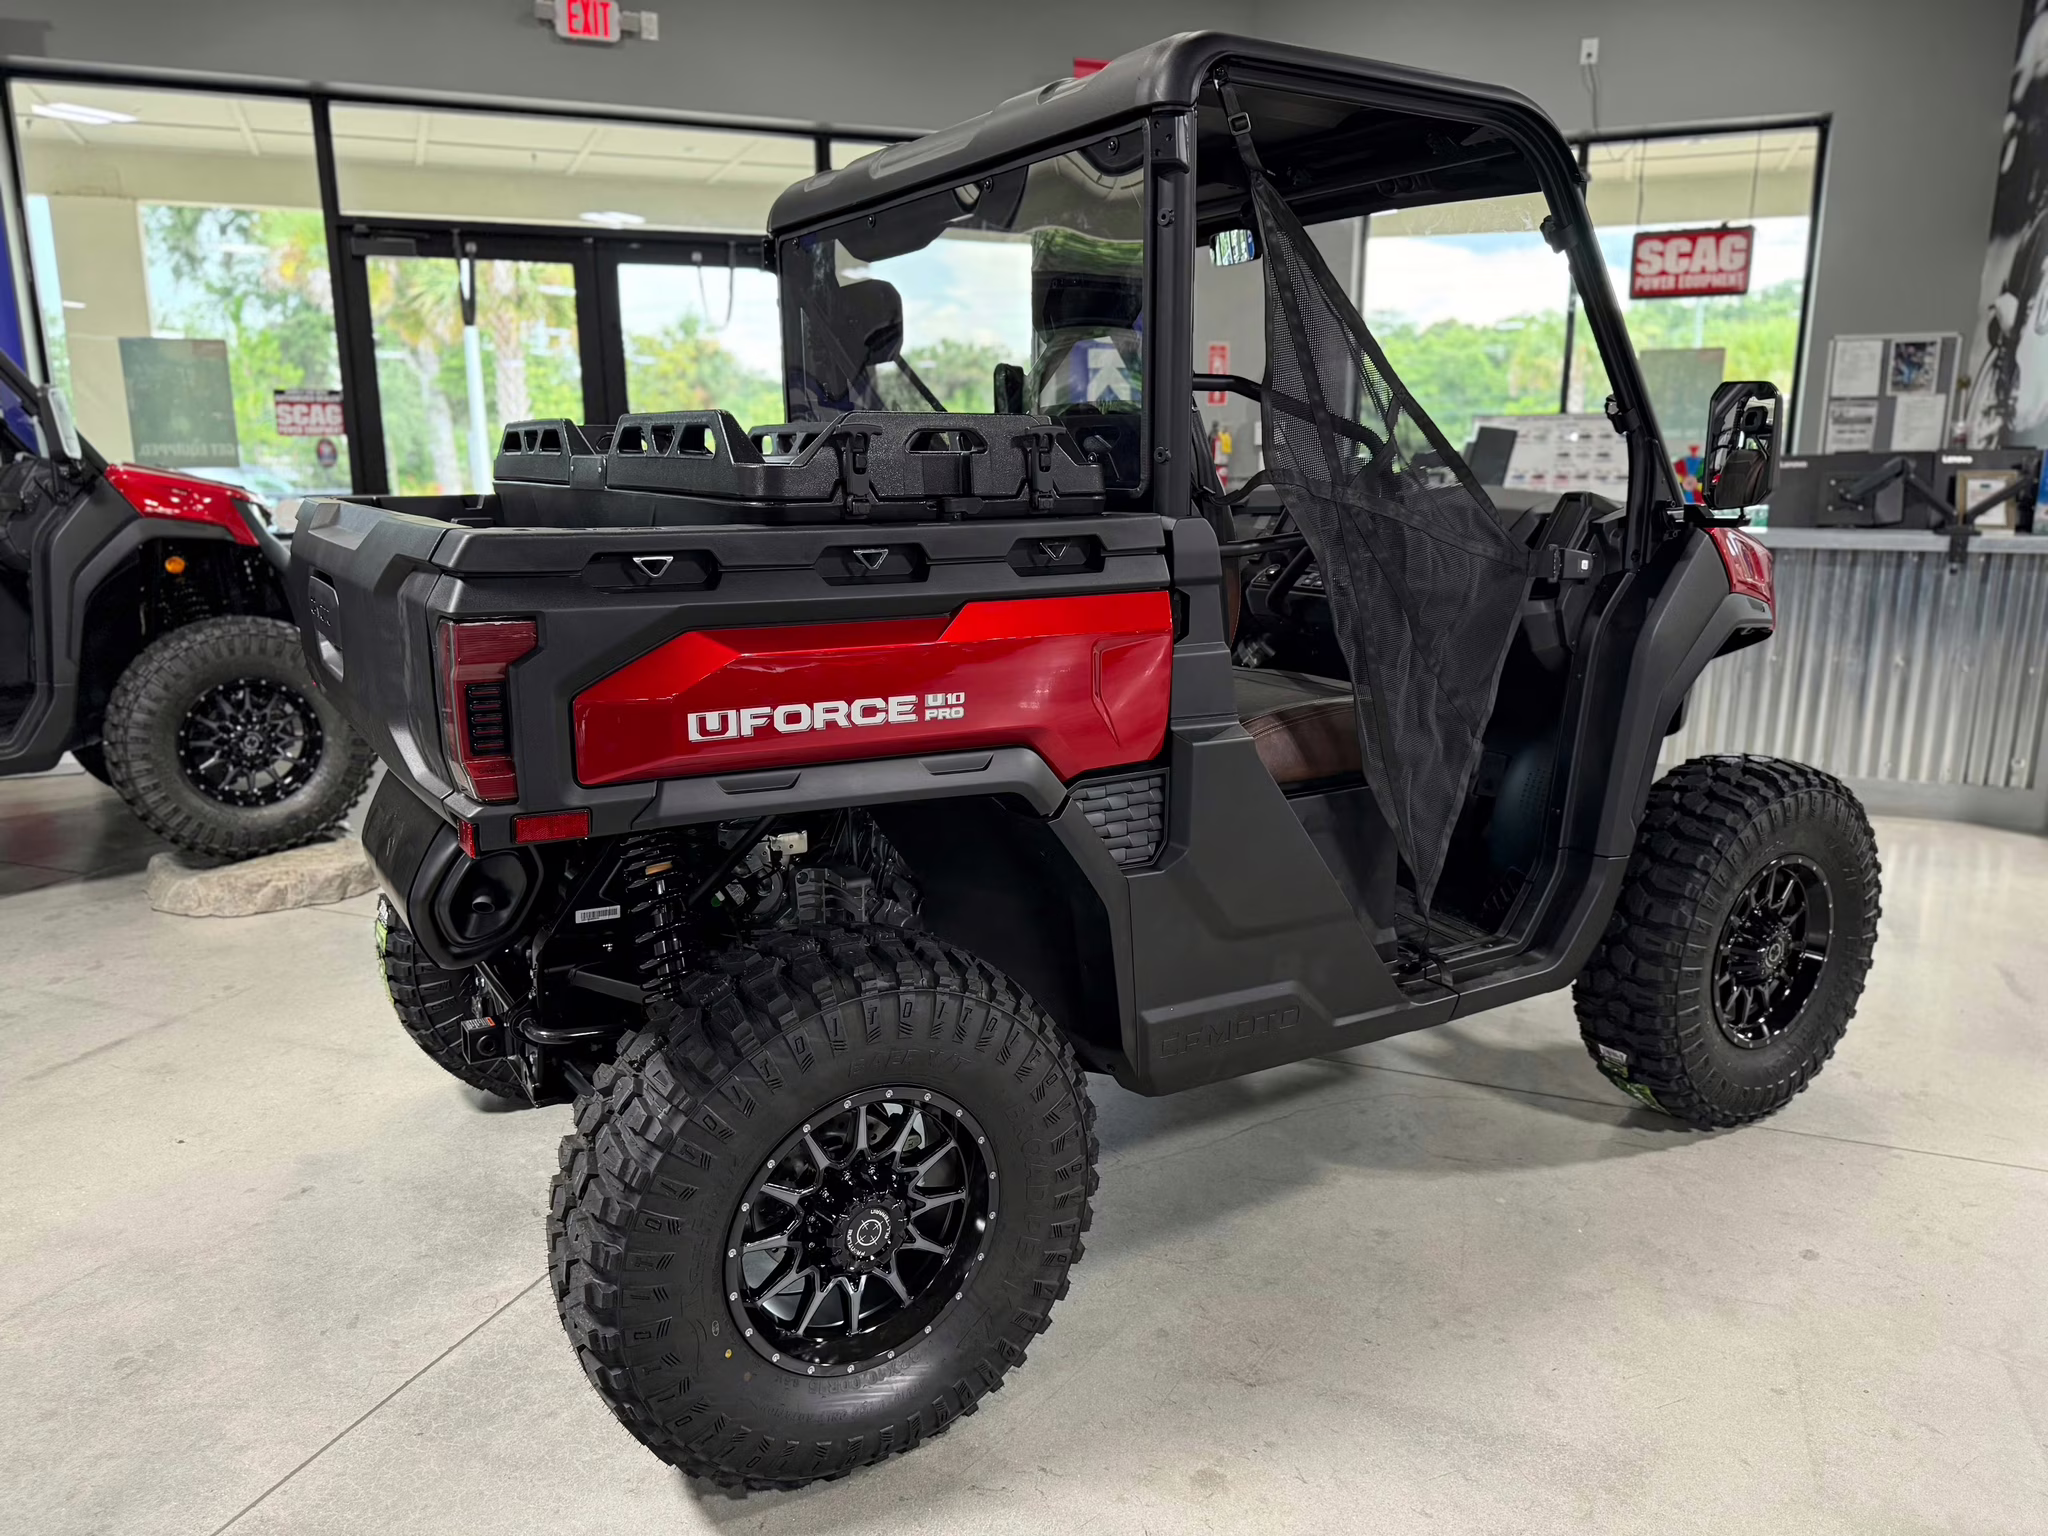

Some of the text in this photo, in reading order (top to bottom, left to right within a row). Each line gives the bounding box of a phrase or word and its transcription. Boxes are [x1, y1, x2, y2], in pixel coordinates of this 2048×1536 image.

[567, 0, 612, 39] EXIT
[1636, 233, 1748, 276] SCAG
[276, 403, 343, 426] SCAG
[687, 692, 965, 743] UFORCE U10
[924, 707, 965, 721] PRO
[1159, 1004, 1300, 1060] CFMOTO
